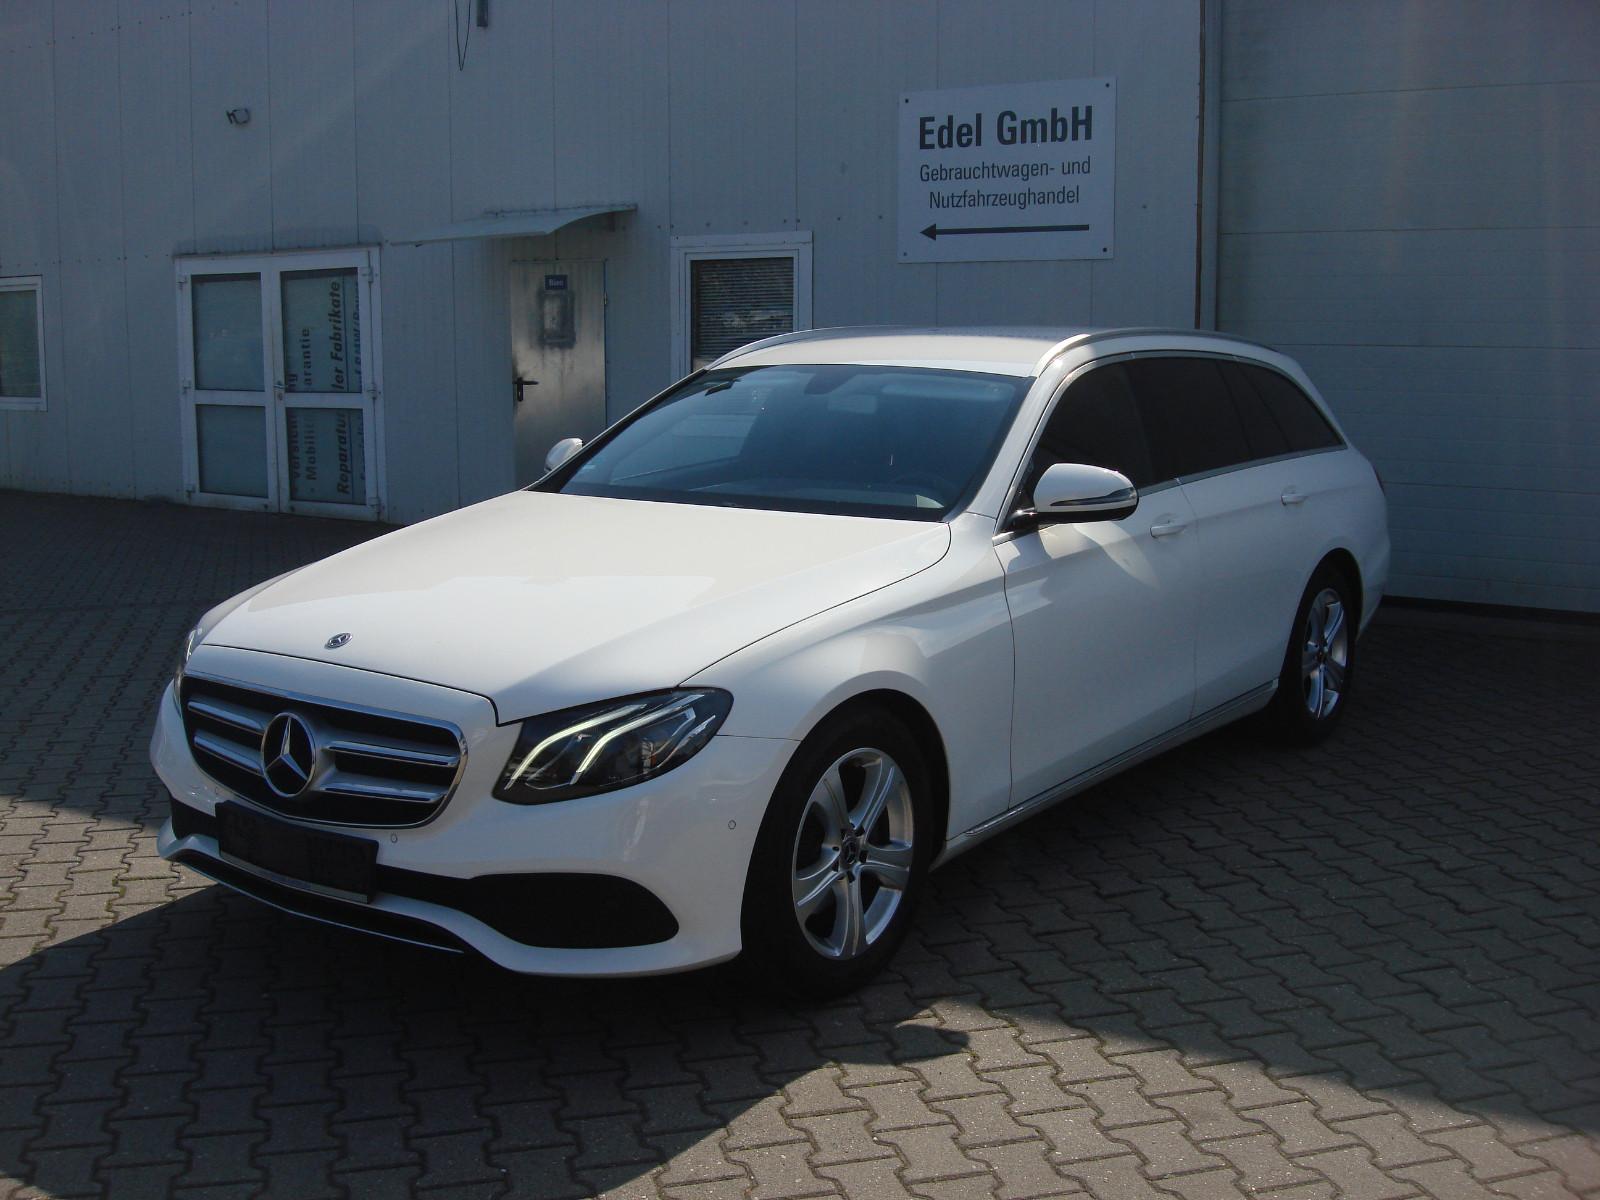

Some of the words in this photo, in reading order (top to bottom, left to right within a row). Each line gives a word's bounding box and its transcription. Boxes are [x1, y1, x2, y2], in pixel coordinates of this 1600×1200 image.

[919, 113, 982, 150] Edel
[997, 105, 1093, 146] GmbH
[919, 160, 1055, 182] Gebrauchtwagen-
[1061, 155, 1091, 176] und
[929, 184, 1079, 210] Nutzfahrzeughandel
[328, 281, 344, 362] Fabrikate
